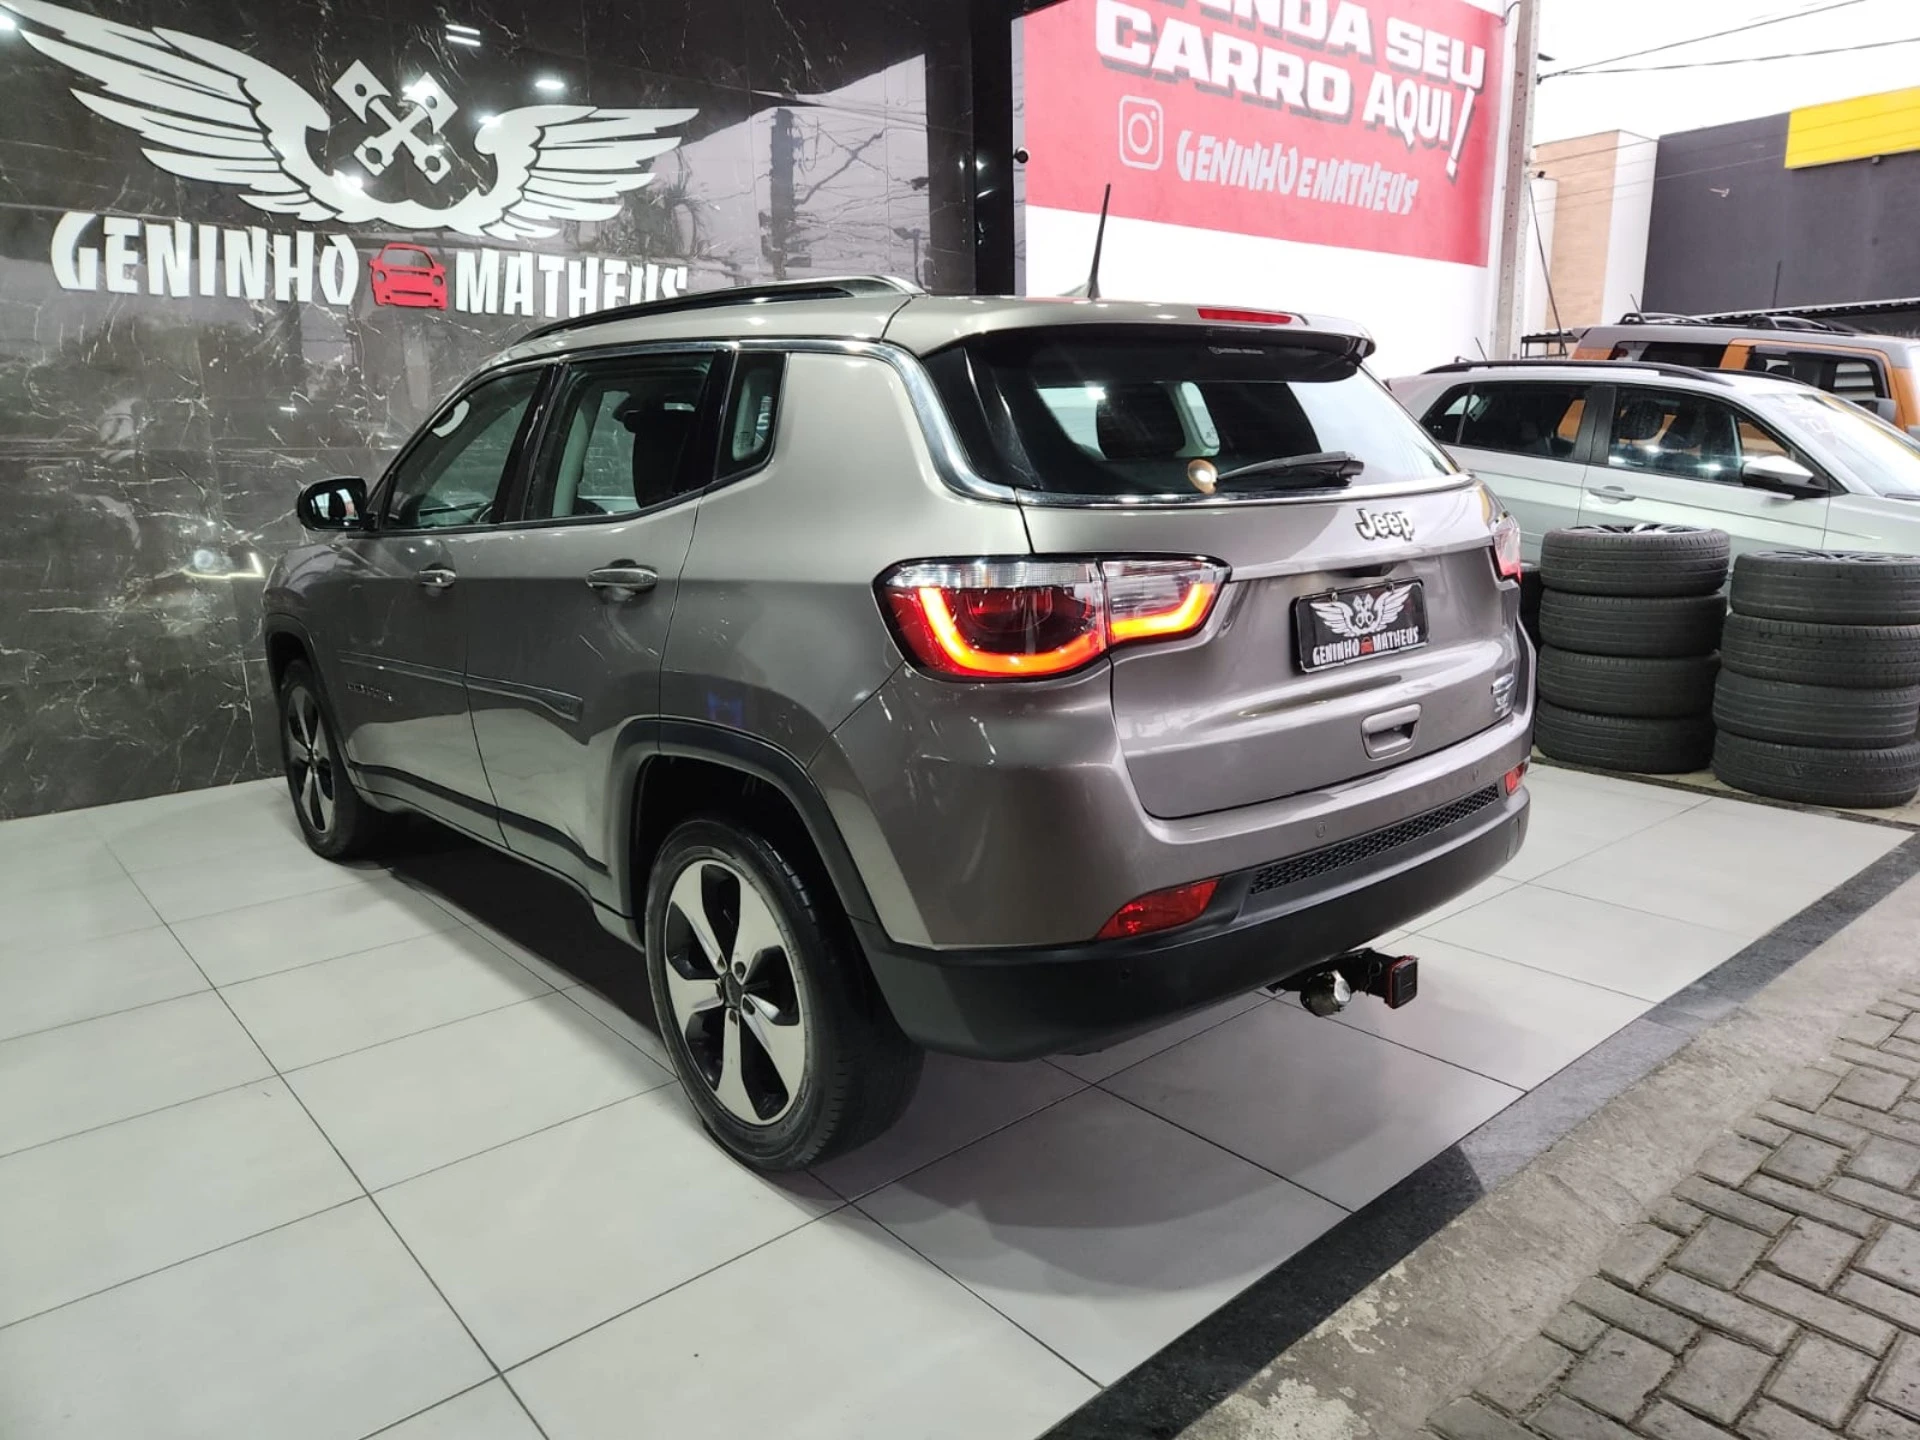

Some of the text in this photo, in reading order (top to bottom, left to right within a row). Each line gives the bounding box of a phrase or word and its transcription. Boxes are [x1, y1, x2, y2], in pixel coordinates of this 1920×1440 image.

[1096, 0, 1476, 178] CARRO AQUI!
[1385, 17, 1486, 89] SEU
[51, 211, 688, 318] GENINHO MATHEUS
[1355, 508, 1415, 542] Jeep
[1312, 626, 1420, 666] GENINHO MATHEUS
